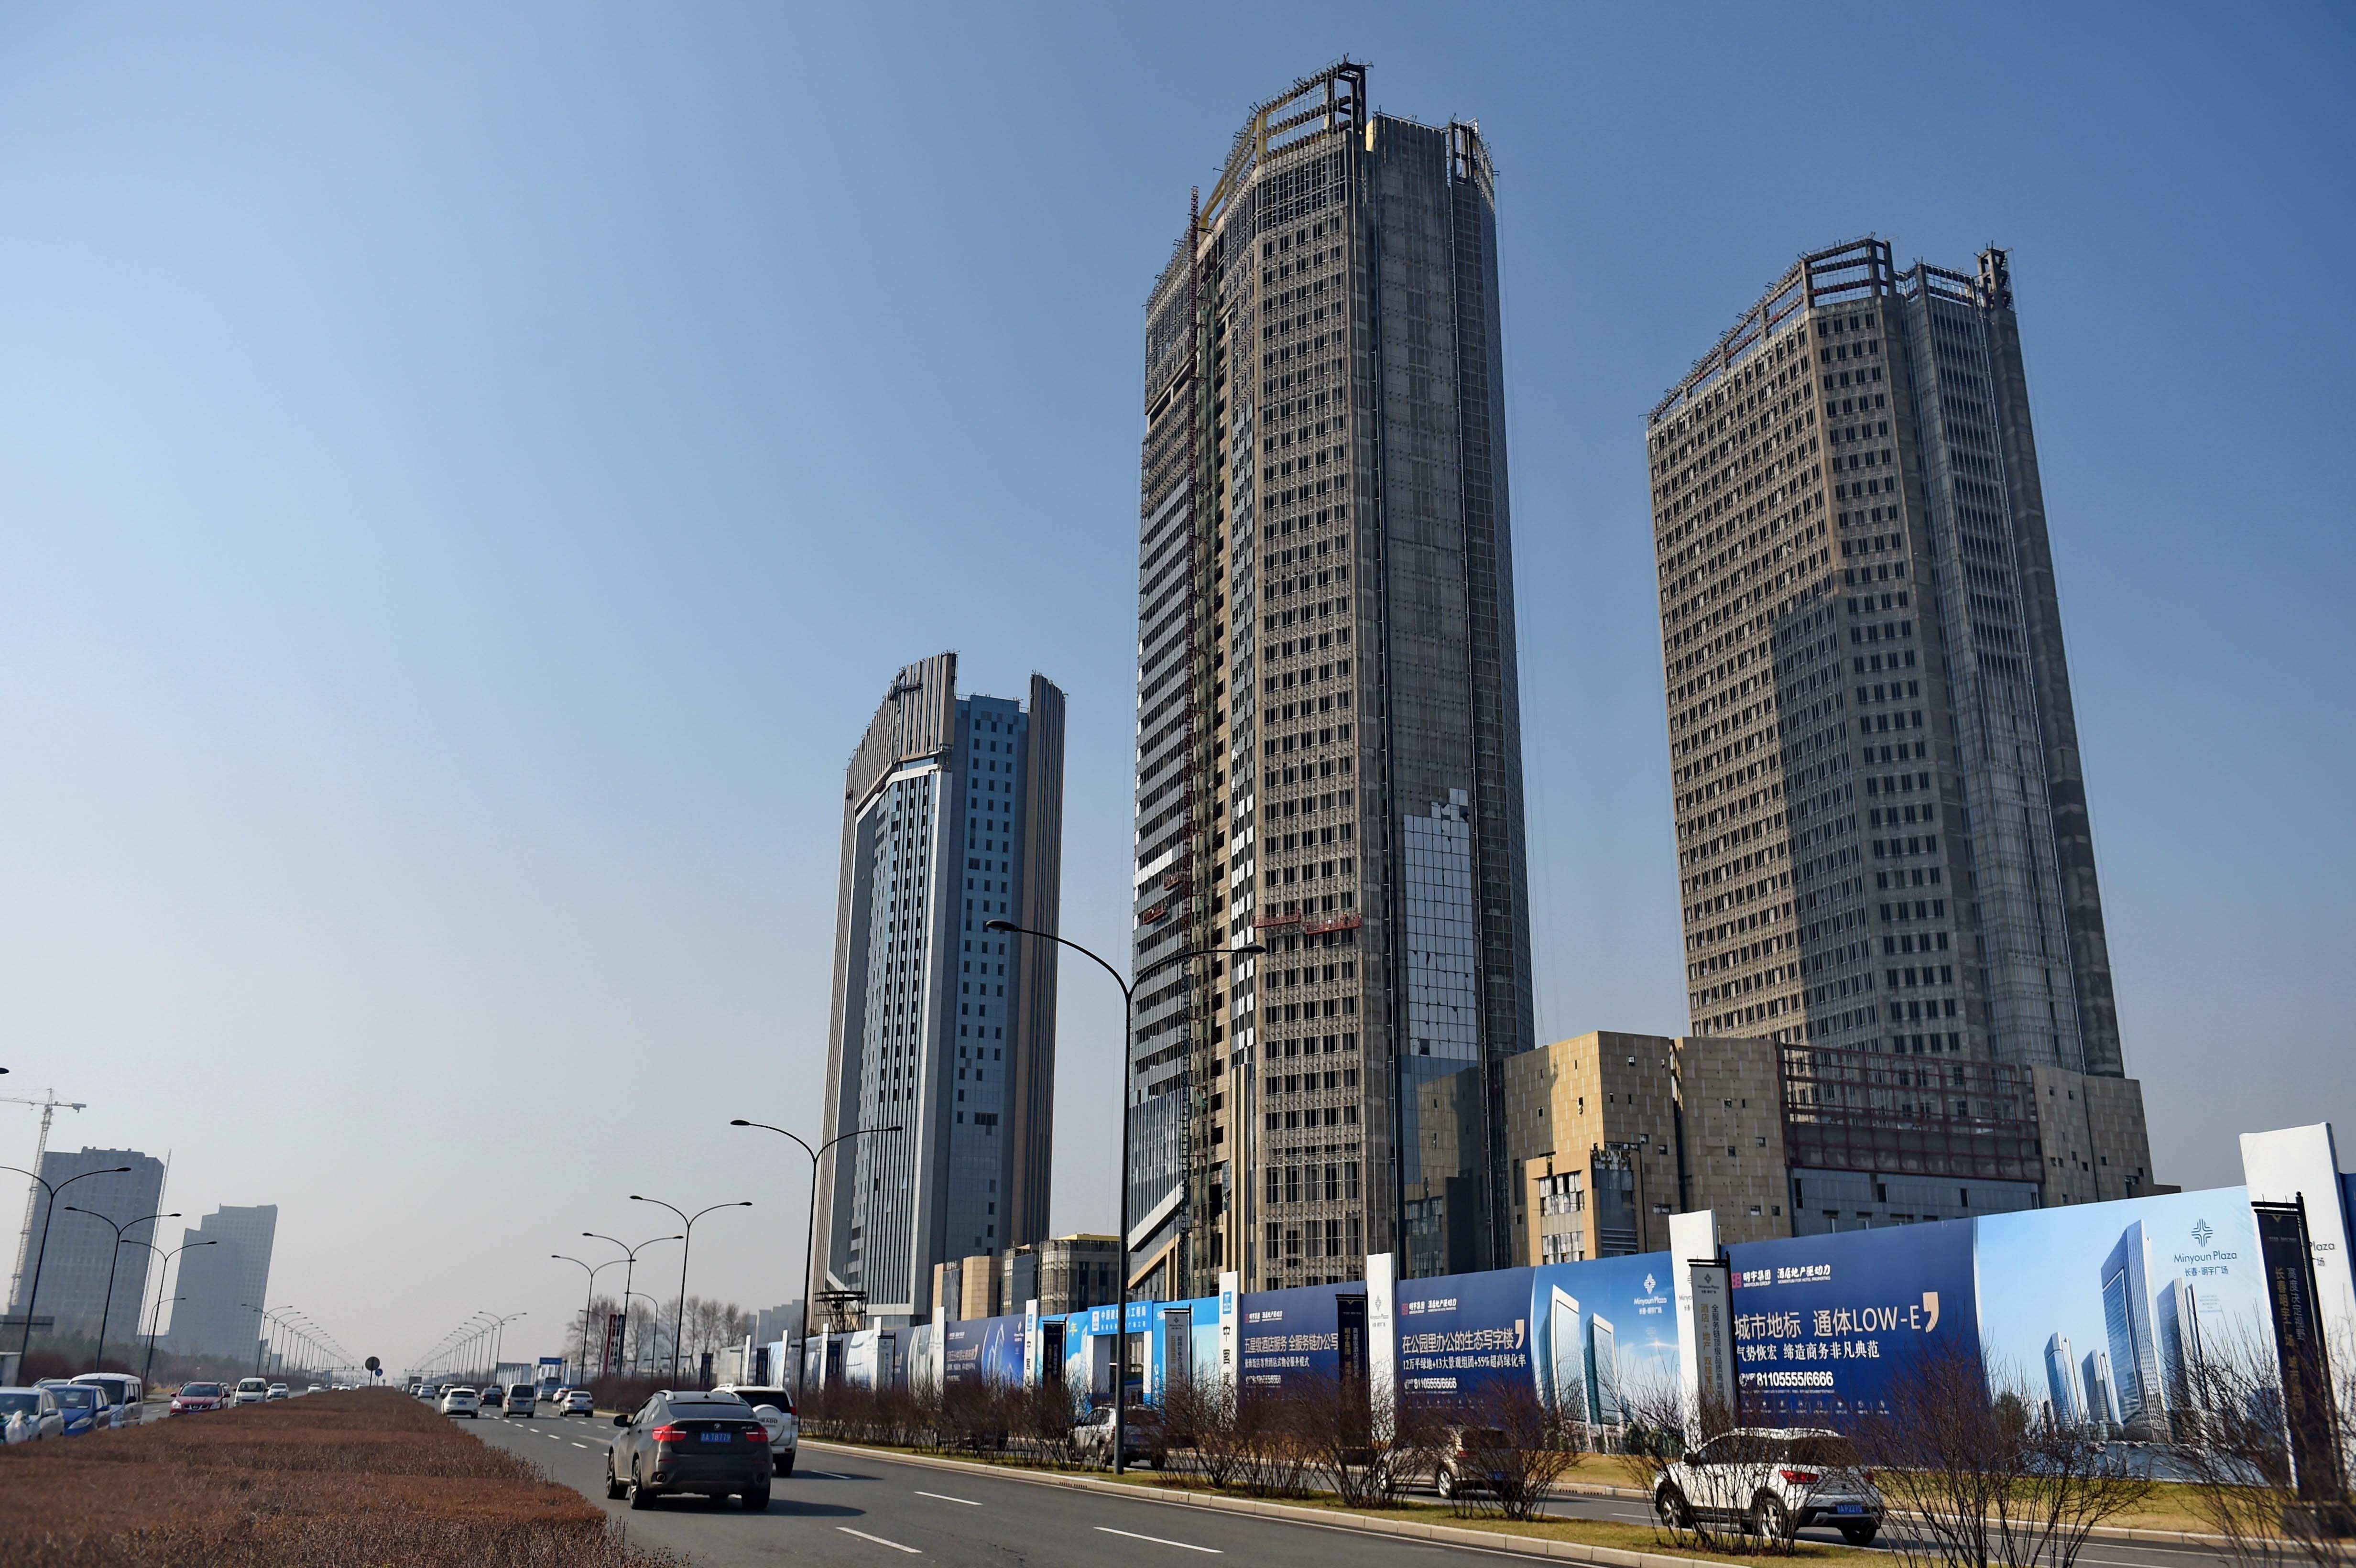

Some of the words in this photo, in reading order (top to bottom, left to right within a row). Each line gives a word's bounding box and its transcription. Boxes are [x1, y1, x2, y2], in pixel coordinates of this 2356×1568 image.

[2174, 1253, 2212, 1264] Minyoun
[2213, 1250, 2237, 1261] Plaza
[1743, 1269, 1771, 1282] 明宇集团
[1734, 1311, 1802, 1340] 城市地标
[1402, 1328, 1514, 1355] 在公园里办公的生态写字楼
[1783, 1340, 1880, 1361] 缔造商务非凡典范
[1756, 1371, 1834, 1387] 81105555/6666
